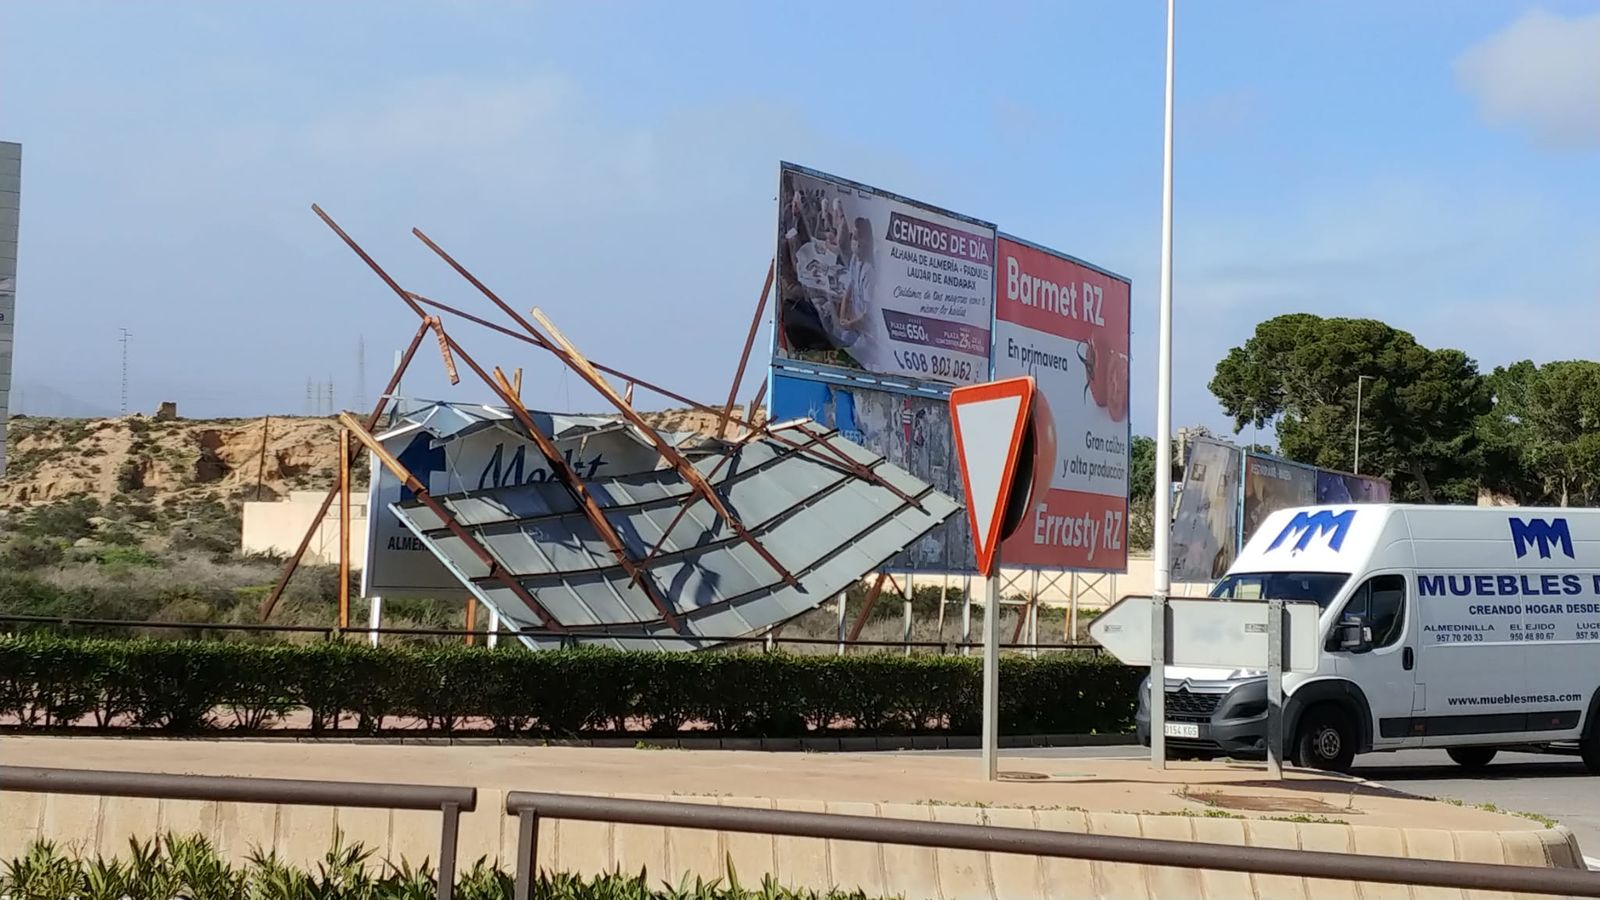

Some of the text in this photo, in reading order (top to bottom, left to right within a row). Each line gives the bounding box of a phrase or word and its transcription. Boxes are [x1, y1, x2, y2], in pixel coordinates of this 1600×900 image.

[893, 219, 988, 262] CENTROS DE DÍA
[891, 247, 918, 264] ALHAMA
[920, 255, 928, 266] DE
[929, 257, 959, 272] ALMERÍA
[907, 266, 976, 291] LAUJAR DE ANDARAX
[1007, 256, 1104, 327] Barmet RZ
[904, 350, 972, 380] 608 803 062
[1008, 338, 1019, 360] En
[1022, 344, 1068, 371] primavera
[1086, 430, 1125, 455] Gran calibre
[1062, 458, 1068, 478] y
[1070, 455, 1088, 476] alta
[1034, 503, 1122, 560] Errasty RZ
[1418, 574, 1582, 596] MUEBLES
[1468, 604, 1600, 615] CREANDO HOGAR DESDE
[1424, 624, 1495, 632] ALMEDINILLA
[1436, 634, 1484, 642] 957 70 20 33
[1510, 632, 1524, 640] 950
[1448, 694, 1582, 706] www.mueblesmesa.com
